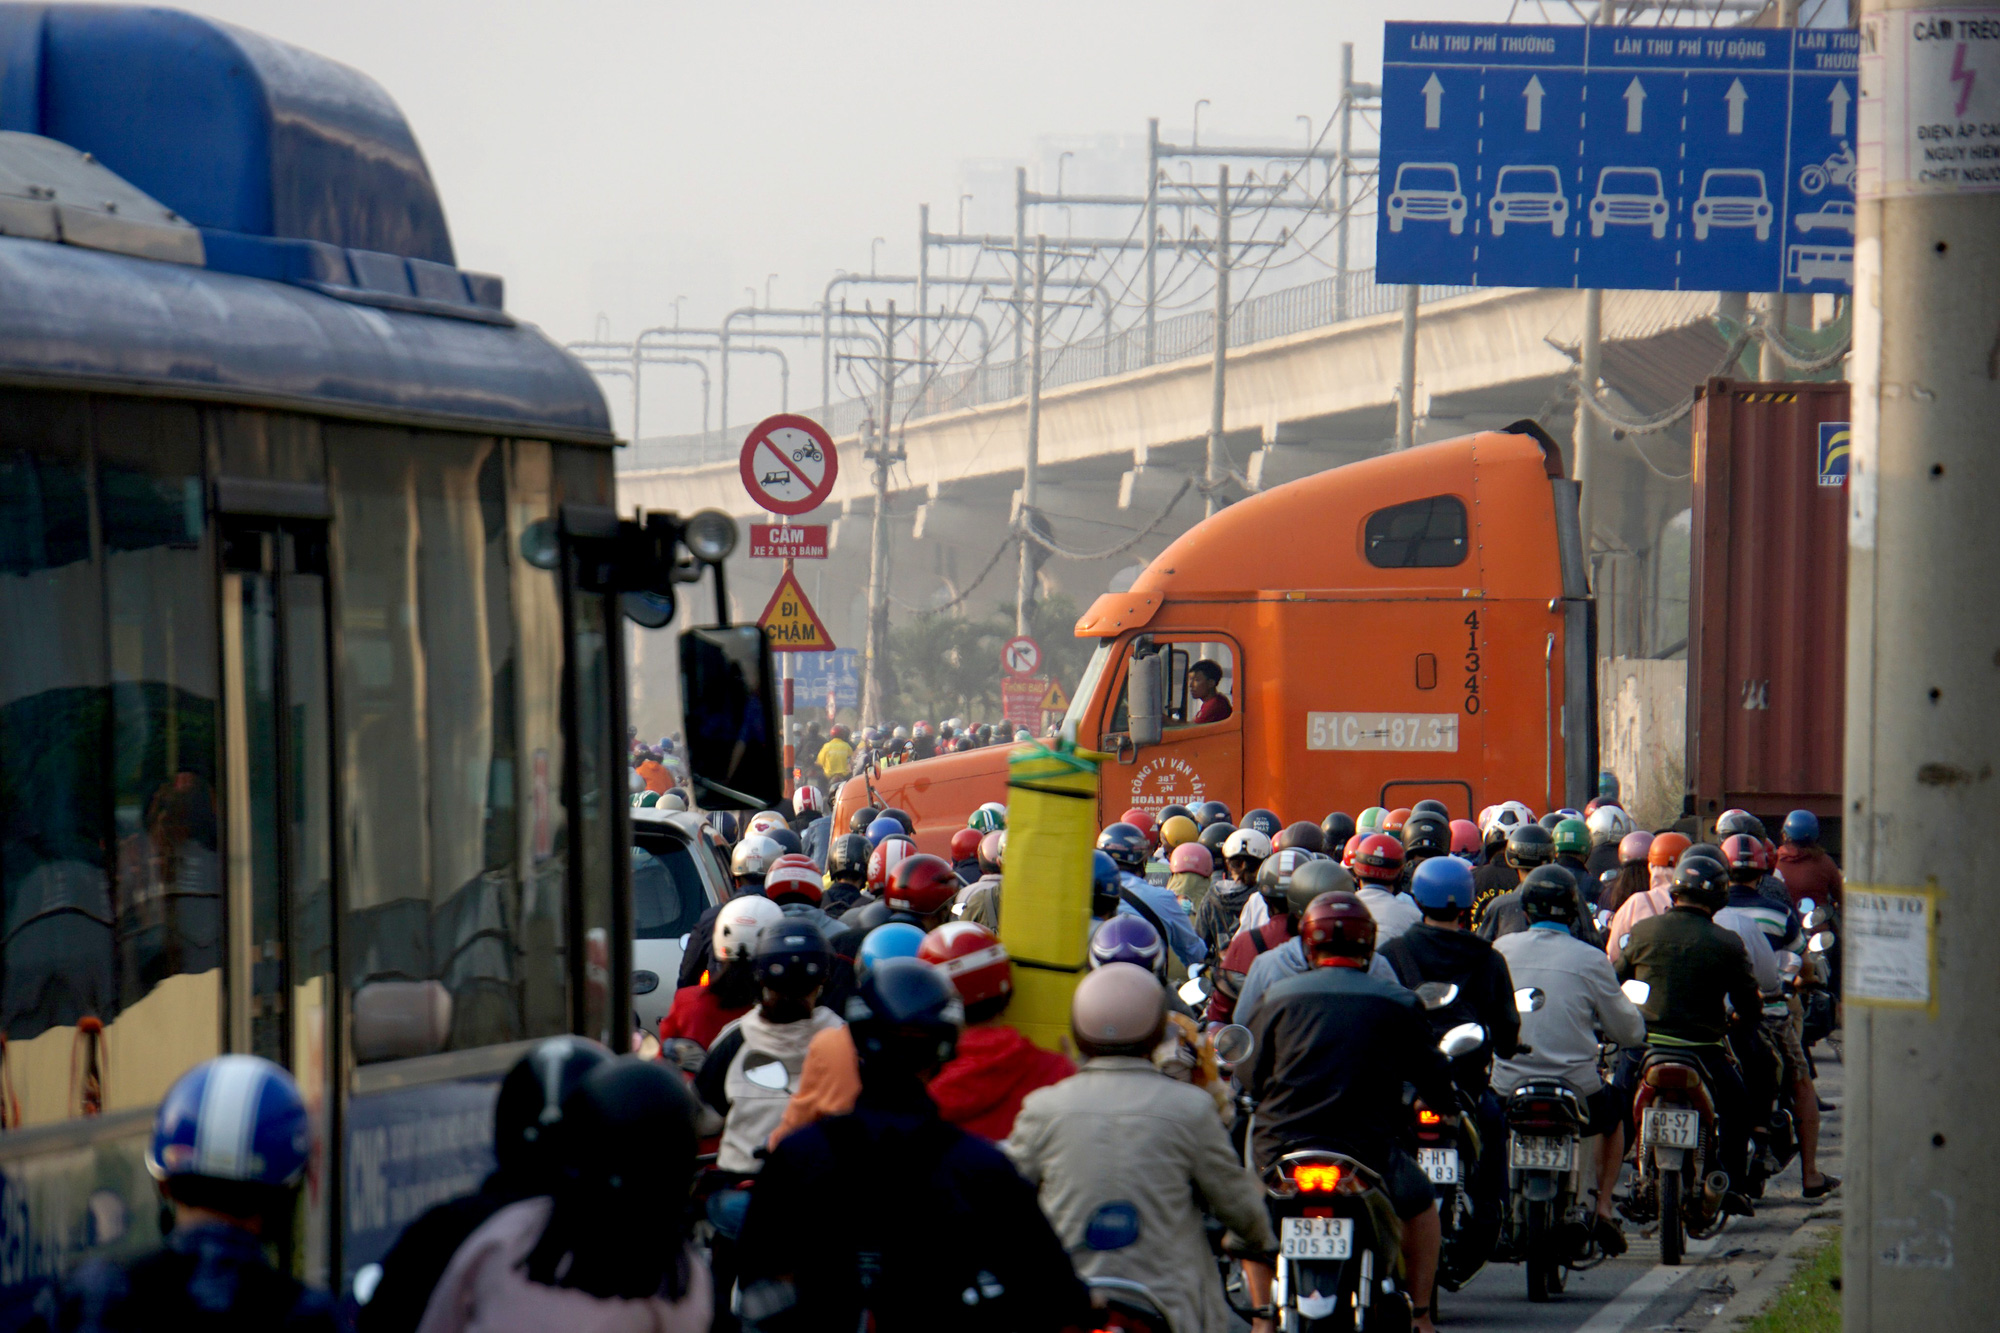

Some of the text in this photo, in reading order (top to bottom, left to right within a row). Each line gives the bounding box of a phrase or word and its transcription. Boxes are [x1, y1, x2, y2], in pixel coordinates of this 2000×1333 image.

[1411, 32, 1438, 50] LÀN
[1444, 35, 1470, 50] THU
[1473, 33, 1498, 51] PHÍ
[1614, 37, 1642, 54] LÀN
[1647, 39, 1673, 55] THU
[1678, 37, 1702, 56] PHÍ
[1832, 33, 1859, 48] THU
[1815, 50, 1859, 69] THƯỜN
[754, 546, 766, 556] XE
[768, 546, 775, 556] 2
[791, 546, 797, 556] 3
[799, 544, 824, 556] BÁNH
[782, 602, 798, 617] ĐI
[765, 620, 815, 643] CHẬM
[1131, 765, 1152, 794] CÔNG
[1151, 757, 1166, 770] TY
[1170, 758, 1193, 776] VẬN
[1652, 1112, 1689, 1128] 60-S7
[1651, 1128, 1688, 1144] 3517
[1294, 1219, 1342, 1236] 59-X3
